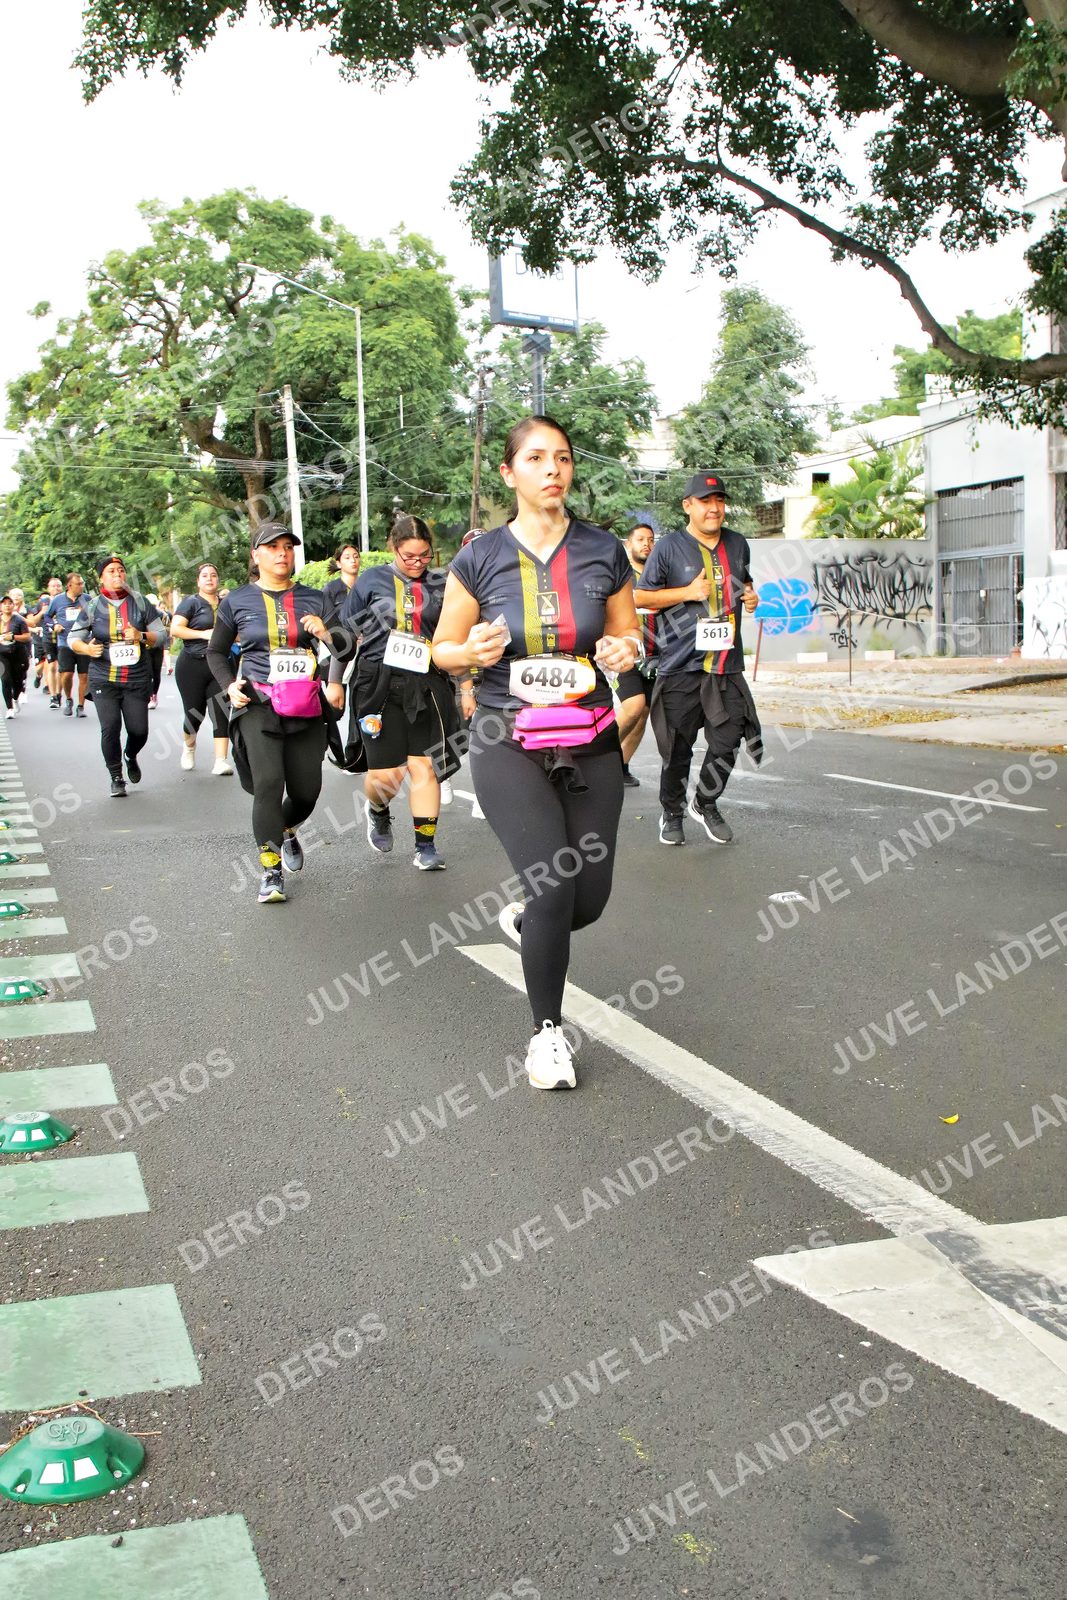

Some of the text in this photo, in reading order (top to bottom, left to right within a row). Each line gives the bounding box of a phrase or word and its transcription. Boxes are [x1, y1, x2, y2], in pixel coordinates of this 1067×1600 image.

[702, 627, 729, 640] 5613
[114, 648, 135, 658] 5532
[392, 642, 423, 659] 6170
[276, 659, 305, 673] 6162
[520, 666, 577, 689] 6484
